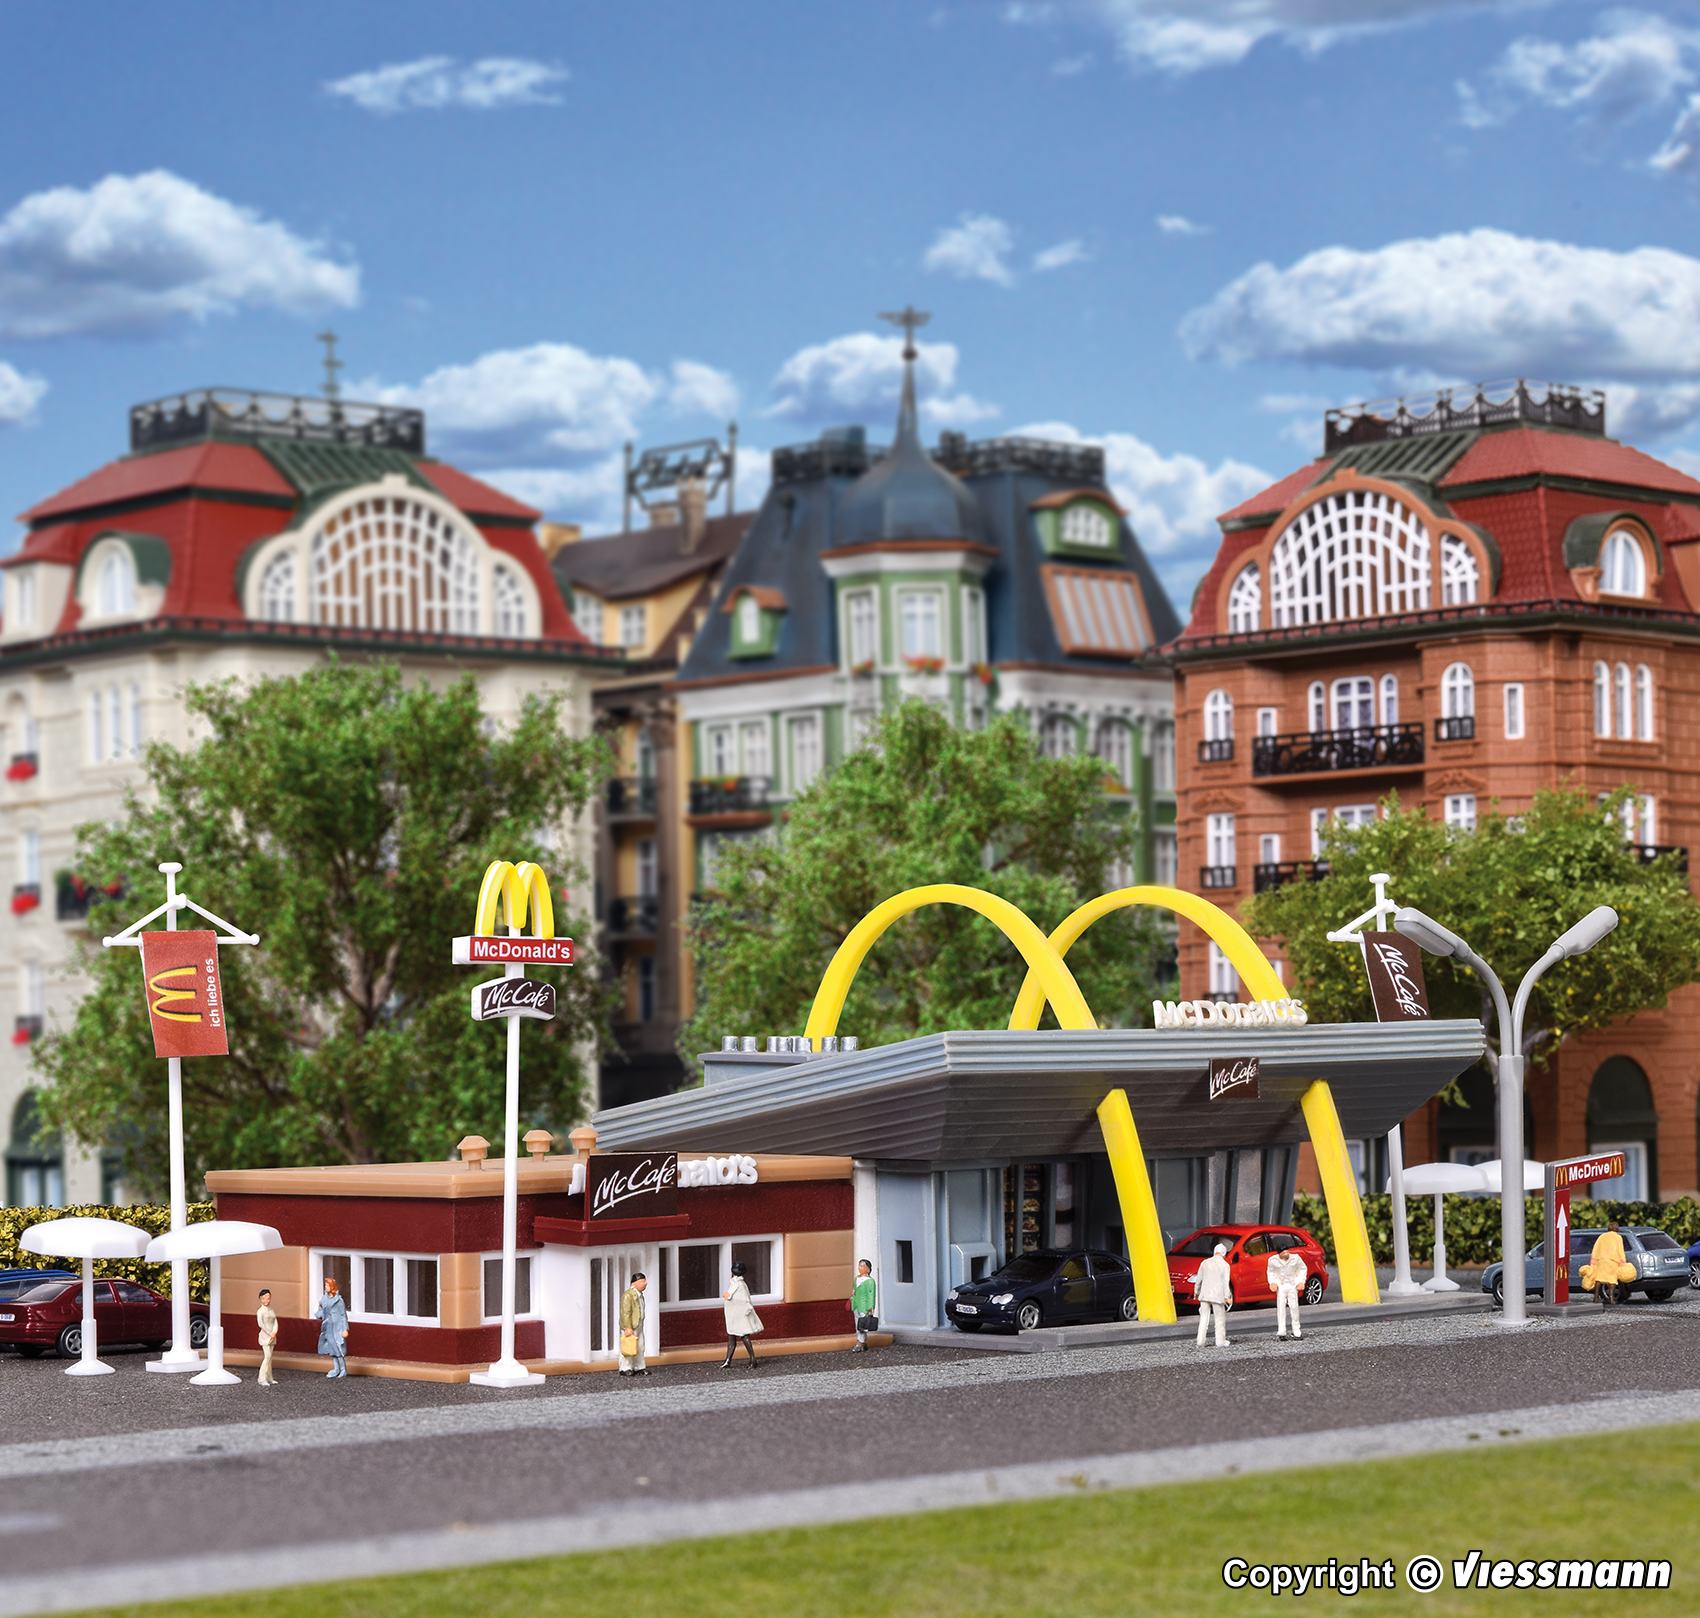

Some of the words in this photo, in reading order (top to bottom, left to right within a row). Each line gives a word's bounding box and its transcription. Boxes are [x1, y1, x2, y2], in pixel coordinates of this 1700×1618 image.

[474, 941, 570, 959] McDonald's
[205, 958, 214, 973] es
[1378, 944, 1427, 1016] McCafé
[206, 976, 217, 1006] liebe
[484, 981, 549, 1013] McCafé
[210, 1009, 220, 1027] ich
[1210, 1057, 1257, 1095] McCafé
[593, 1155, 677, 1210] McCafé
[1569, 1162, 1610, 1181] McDrive
